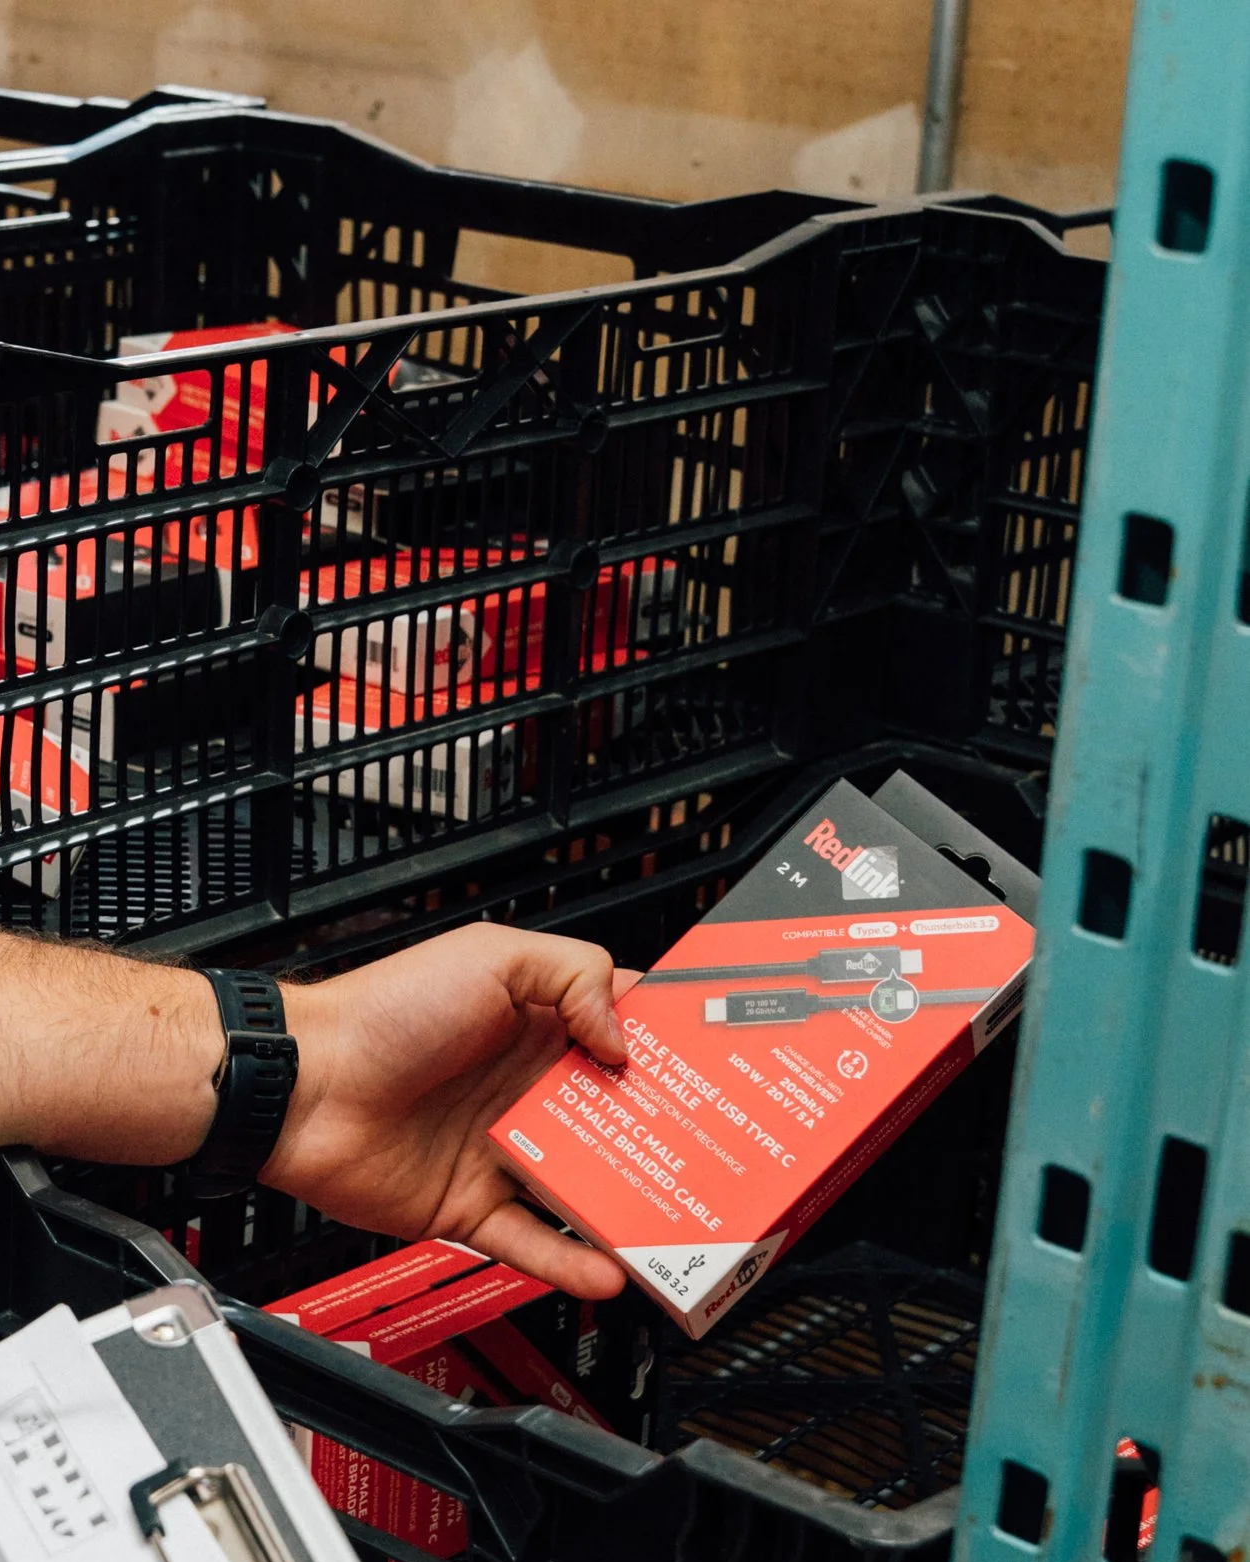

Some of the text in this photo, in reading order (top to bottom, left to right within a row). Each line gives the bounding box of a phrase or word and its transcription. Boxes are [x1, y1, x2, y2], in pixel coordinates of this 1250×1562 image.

[776, 862, 808, 888] 2 M
[803, 817, 900, 899] Redlink
[782, 928, 845, 940] COMPATIBLE
[855, 925, 876, 937] Type
[879, 925, 891, 935] C
[914, 919, 978, 932] Thunderbolt
[979, 918, 995, 929] 3.2
[616, 1079, 659, 1118] RAPIDES
[623, 1018, 797, 1168] CÂBLE TRESSÉ USB TYPE C
[646, 1060, 662, 1078] À
[658, 1072, 702, 1110] MÂLE
[727, 1052, 751, 1074] 100
[749, 1068, 765, 1083] W
[766, 1085, 784, 1102] 20
[782, 1097, 795, 1109] V
[795, 1110, 808, 1122] 5
[803, 1118, 815, 1130] A
[770, 1047, 840, 1104] POWER DELIVERY
[779, 1076, 826, 1119] 20Gbit/s
[570, 1069, 687, 1173] USB TYPE C MALE
[680, 1118, 697, 1132] ET
[693, 1129, 747, 1177] RECHARGE
[542, 1098, 682, 1224] ULTRA FAST SYNC AND CHARGE
[557, 1082, 723, 1232] TO MALE BRAIDED CABLE
[648, 1257, 689, 1297] USB 3.2
[357, 1463, 370, 1519] C MALE
